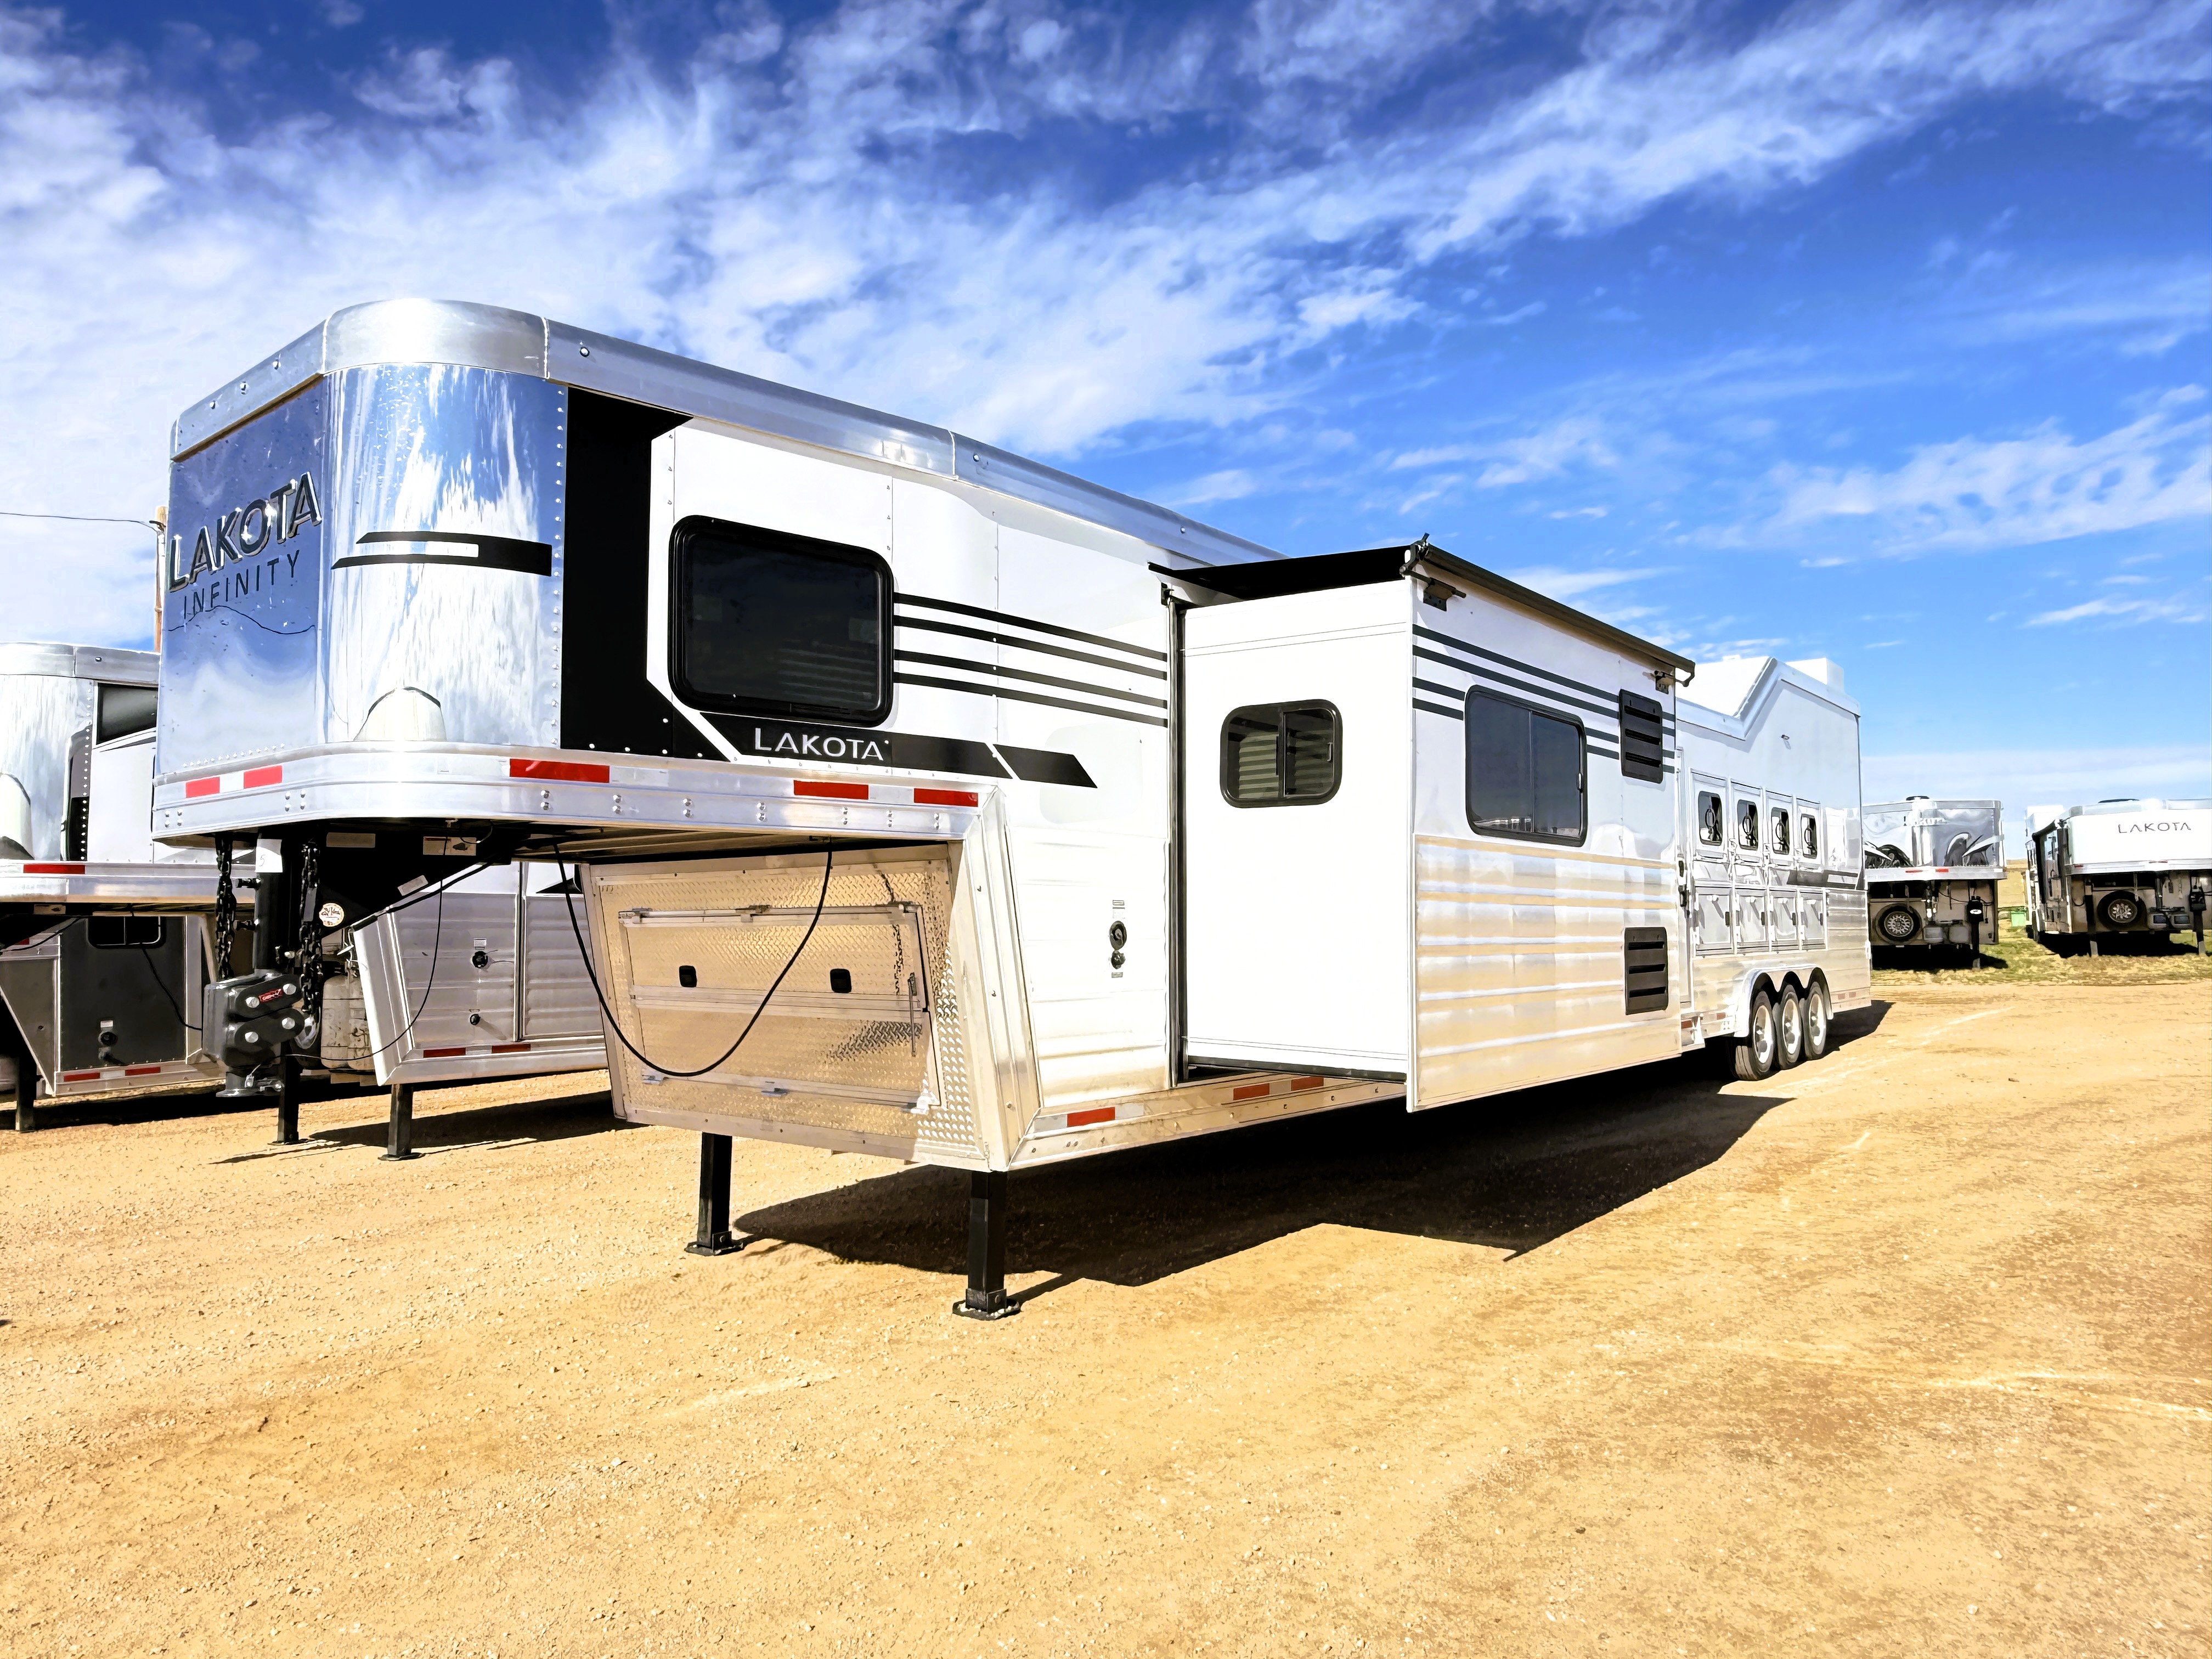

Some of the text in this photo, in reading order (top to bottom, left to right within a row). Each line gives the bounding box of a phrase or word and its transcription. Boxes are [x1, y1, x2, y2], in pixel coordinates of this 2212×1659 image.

[169, 471, 323, 593] LAKOTA
[183, 549, 300, 620] INFINITY
[754, 727, 884, 761] LAKOTA
[2118, 822, 2192, 834] LAKOTA
